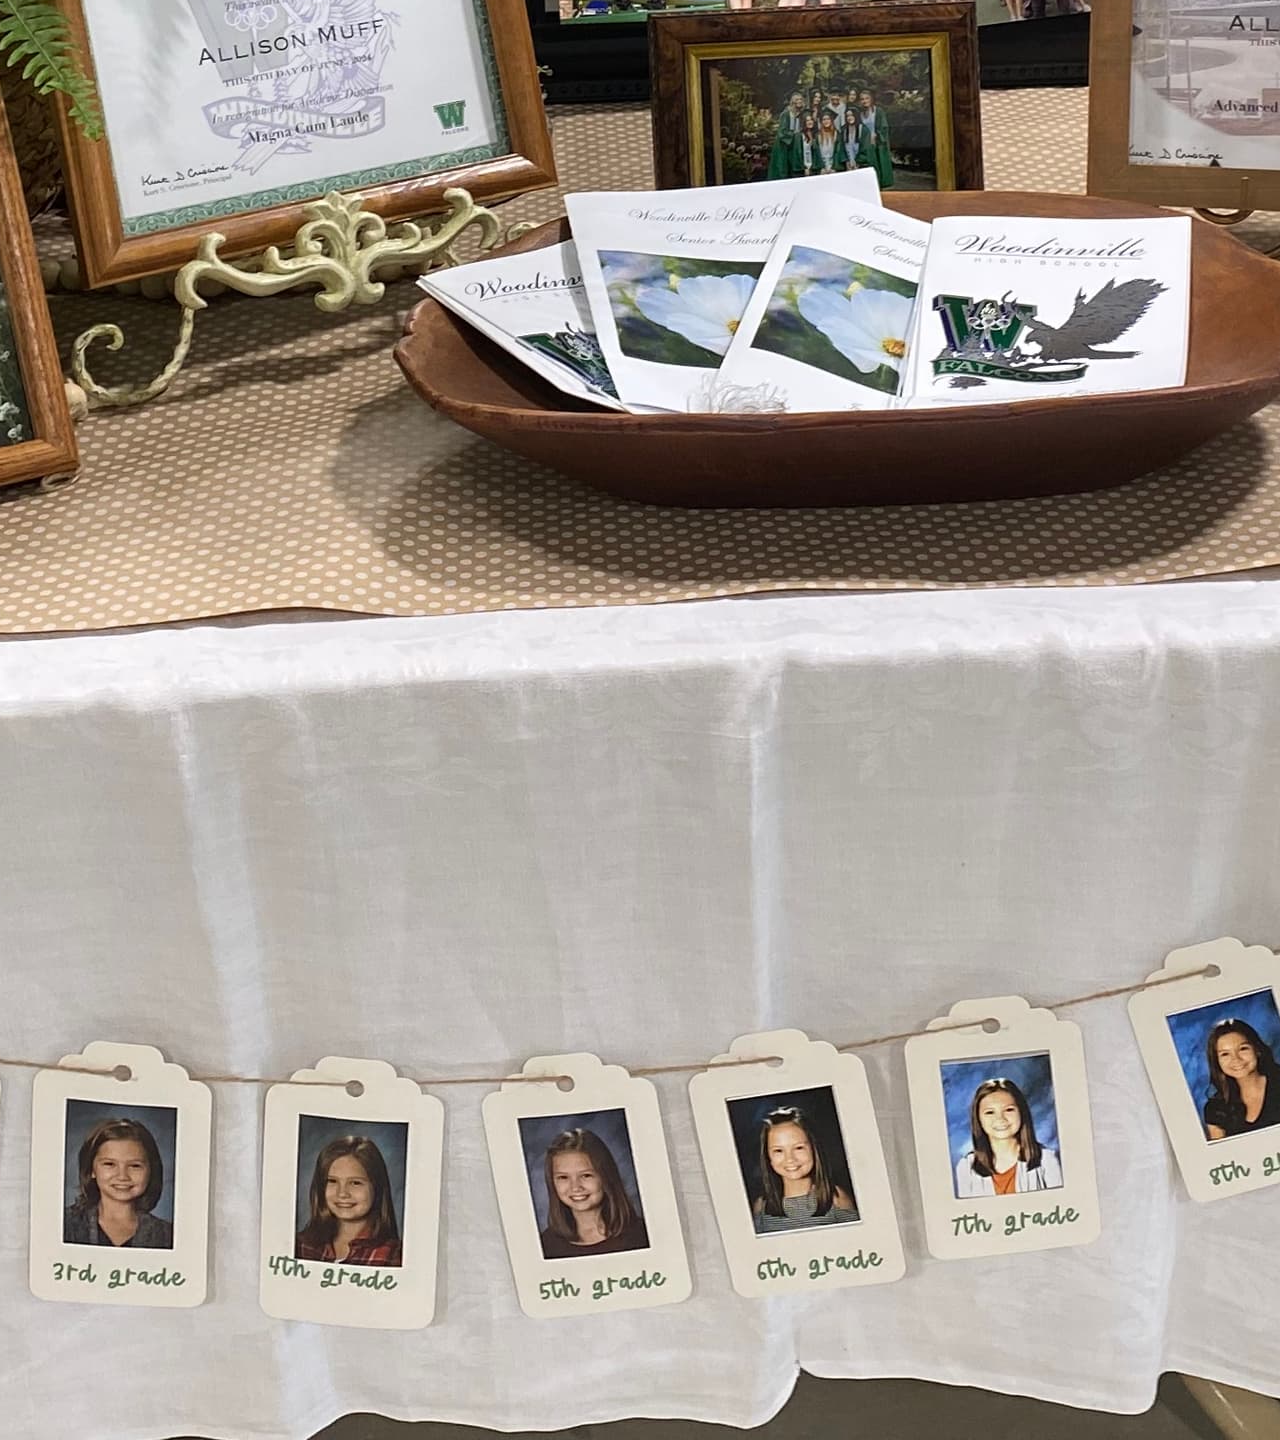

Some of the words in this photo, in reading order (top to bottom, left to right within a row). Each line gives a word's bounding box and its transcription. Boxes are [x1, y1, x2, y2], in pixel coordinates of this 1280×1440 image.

[198, 32, 306, 66] ALLISON
[318, 18, 384, 44] MUFF
[275, 67, 299, 80] DAY
[1214, 99, 1278, 113] Advanced
[249, 127, 292, 145] Magna
[295, 118, 326, 135] Cum
[330, 110, 370, 129] Laude
[628, 207, 710, 223] Woodinville
[714, 206, 754, 226] High
[756, 203, 789, 221] Sch
[666, 231, 716, 246] Senior
[720, 231, 779, 246] Award
[848, 215, 928, 248] Woodinville
[954, 234, 1146, 258] Woodinville
[974, 257, 1022, 265] HIGH
[1040, 259, 1121, 268] SCHOOL
[464, 271, 582, 300] Woodinv
[937, 360, 1084, 382] FALCONS
[1209, 1159, 1251, 1187] 8th
[951, 1212, 993, 1237] 7th
[1004, 1205, 1081, 1237] grade
[52, 1262, 97, 1284] 3rd
[107, 1262, 187, 1289] grade
[268, 1254, 311, 1281] 4th
[320, 1264, 399, 1292] grade
[755, 1256, 797, 1282] 6th
[808, 1247, 885, 1280] grade
[538, 1274, 581, 1302] 5th
[592, 1267, 669, 1300] grade
